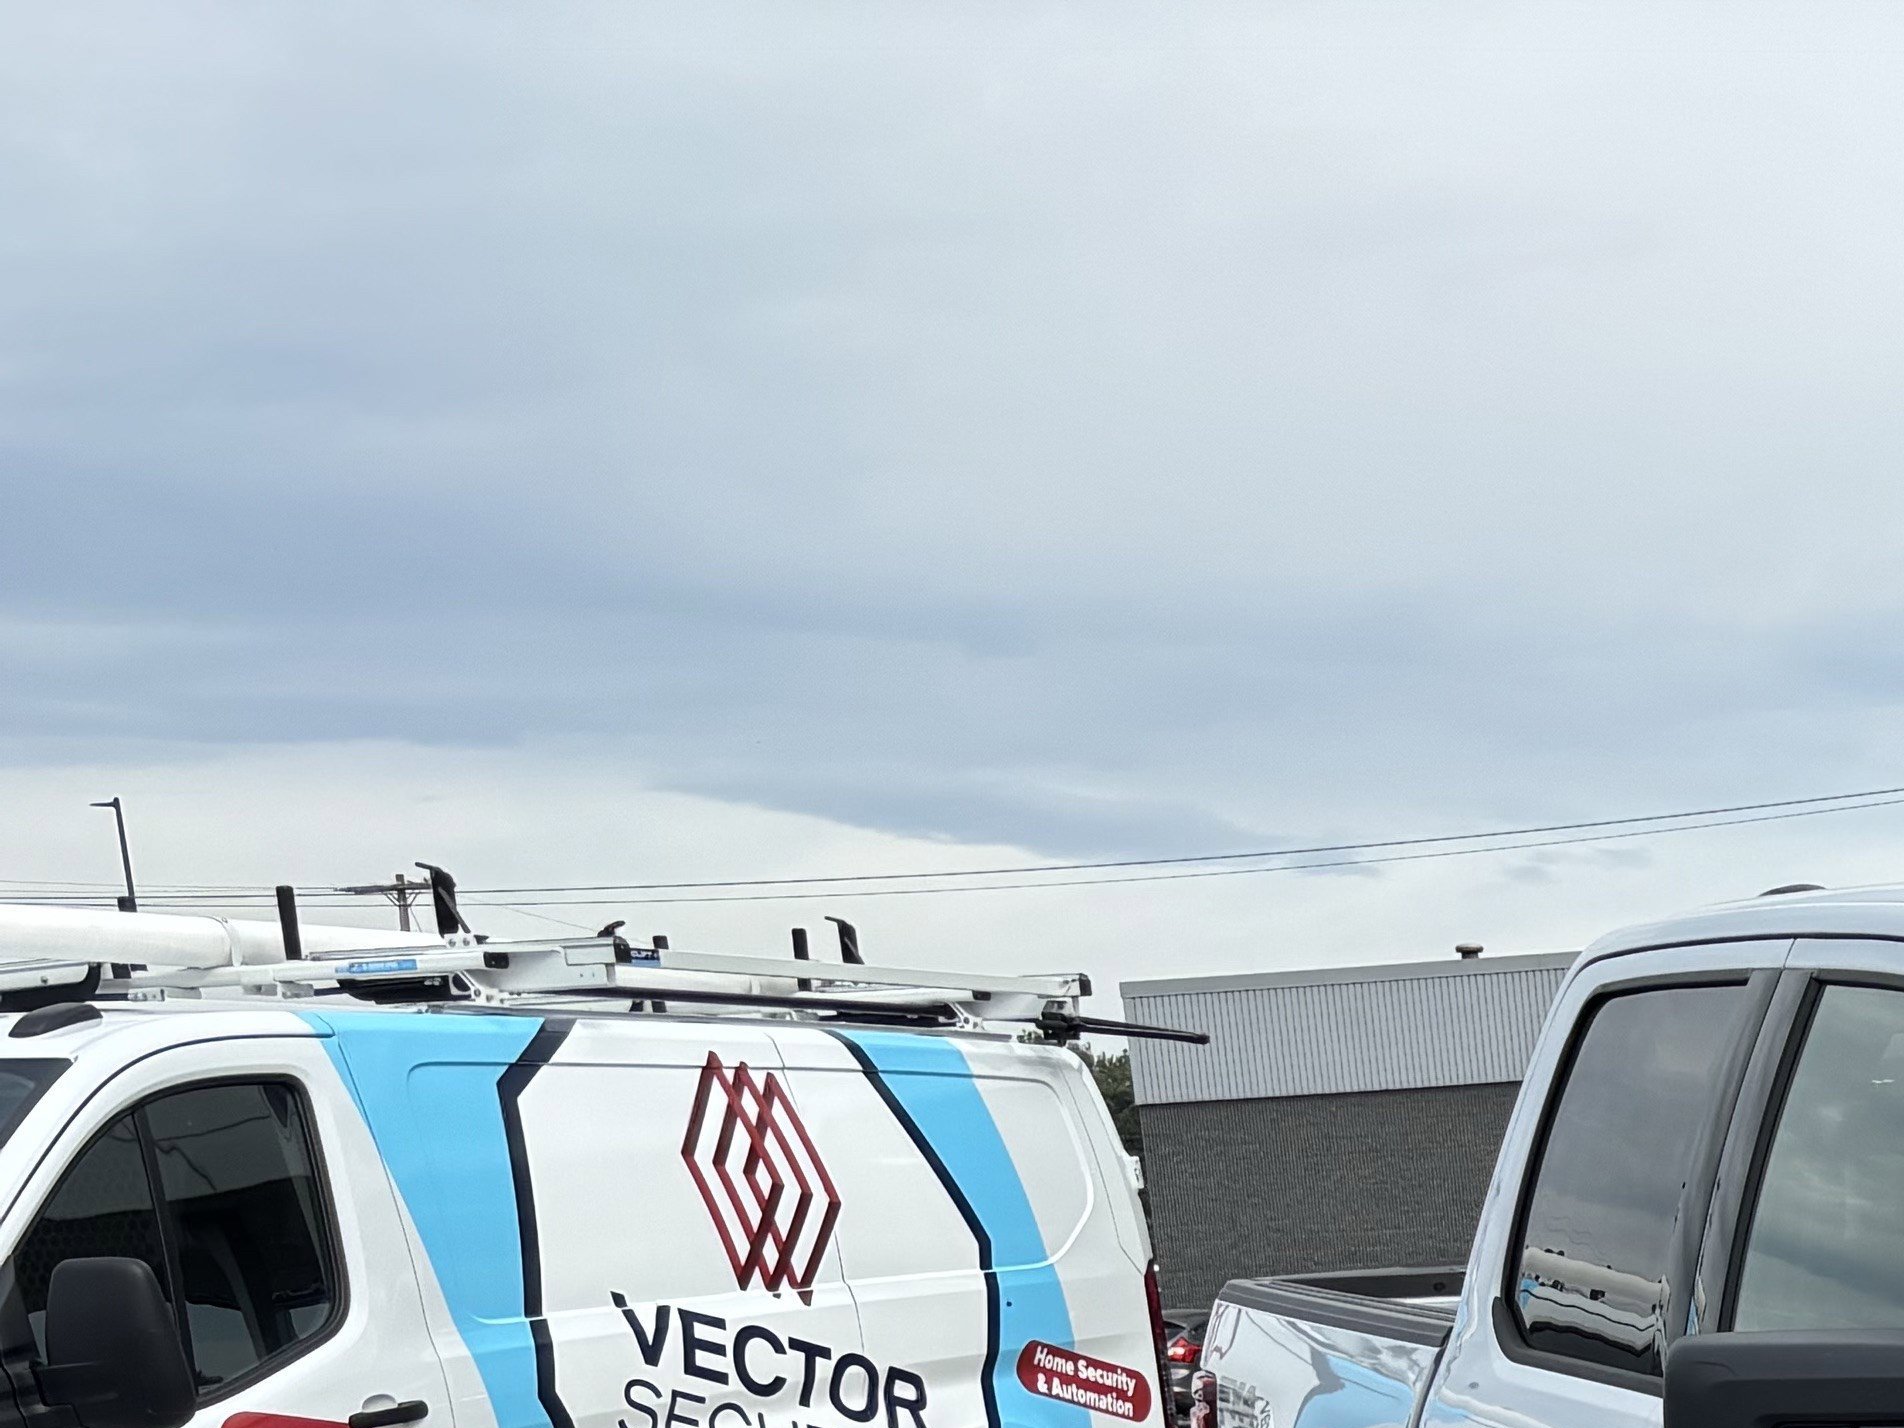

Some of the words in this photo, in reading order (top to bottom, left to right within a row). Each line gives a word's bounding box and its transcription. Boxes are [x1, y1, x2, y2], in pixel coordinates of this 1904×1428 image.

[1033, 1345, 1075, 1376] Home
[1077, 1359, 1137, 1397] Security
[1037, 1372, 1049, 1394] &
[1051, 1377, 1134, 1417] Automation
